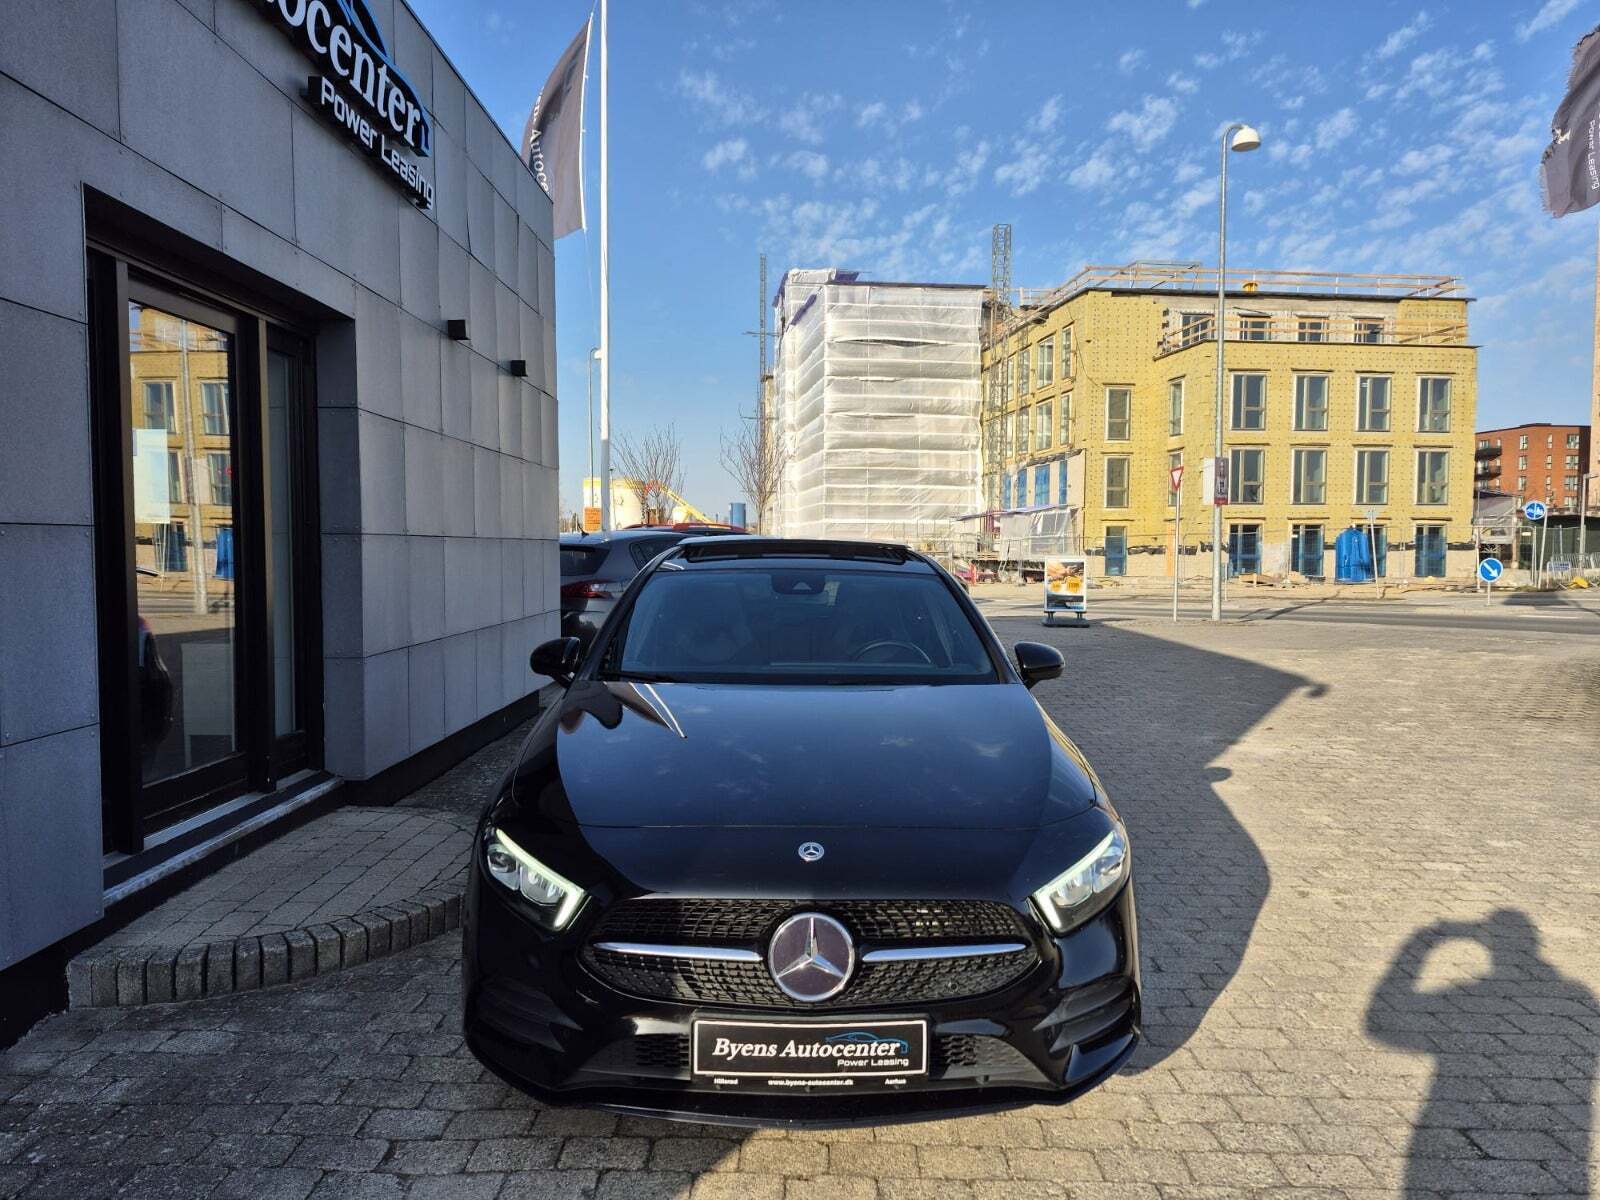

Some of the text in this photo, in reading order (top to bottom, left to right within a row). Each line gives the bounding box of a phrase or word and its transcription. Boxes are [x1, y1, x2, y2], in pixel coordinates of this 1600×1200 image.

[321, 76, 433, 211] Power Leasing
[530, 129, 550, 195] Autoce
[1588, 151, 1600, 190] Leasing
[712, 1038, 900, 1060] Byens Autocenter
[837, 1057, 909, 1067] Power Leasing
